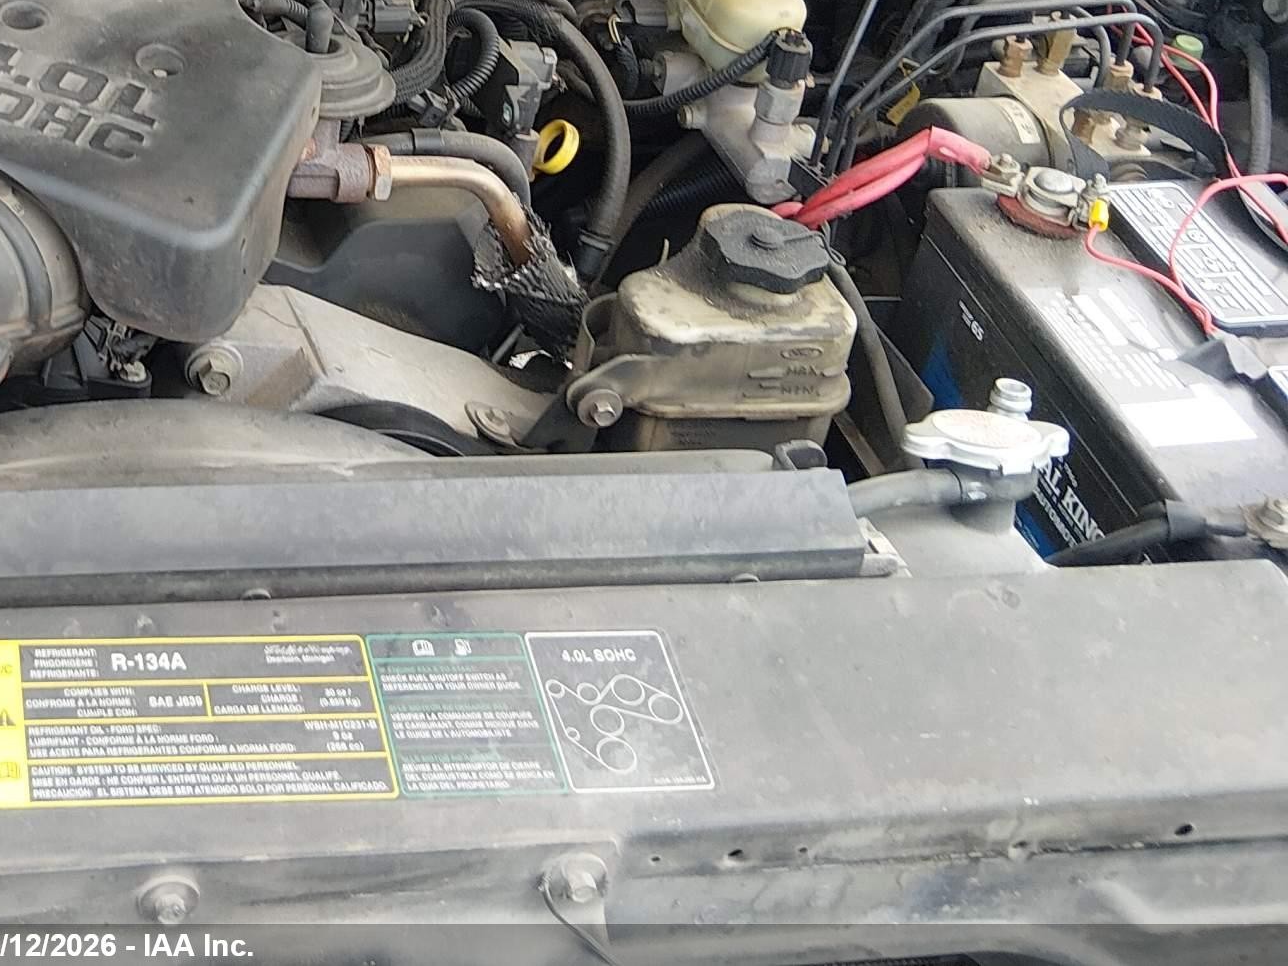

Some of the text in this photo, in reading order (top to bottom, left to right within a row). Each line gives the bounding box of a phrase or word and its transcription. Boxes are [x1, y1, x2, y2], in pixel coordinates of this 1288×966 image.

[110, 652, 187, 672] R-134A
[562, 648, 636, 663] 4.0L SOHC
[148, 696, 173, 708] SAE
